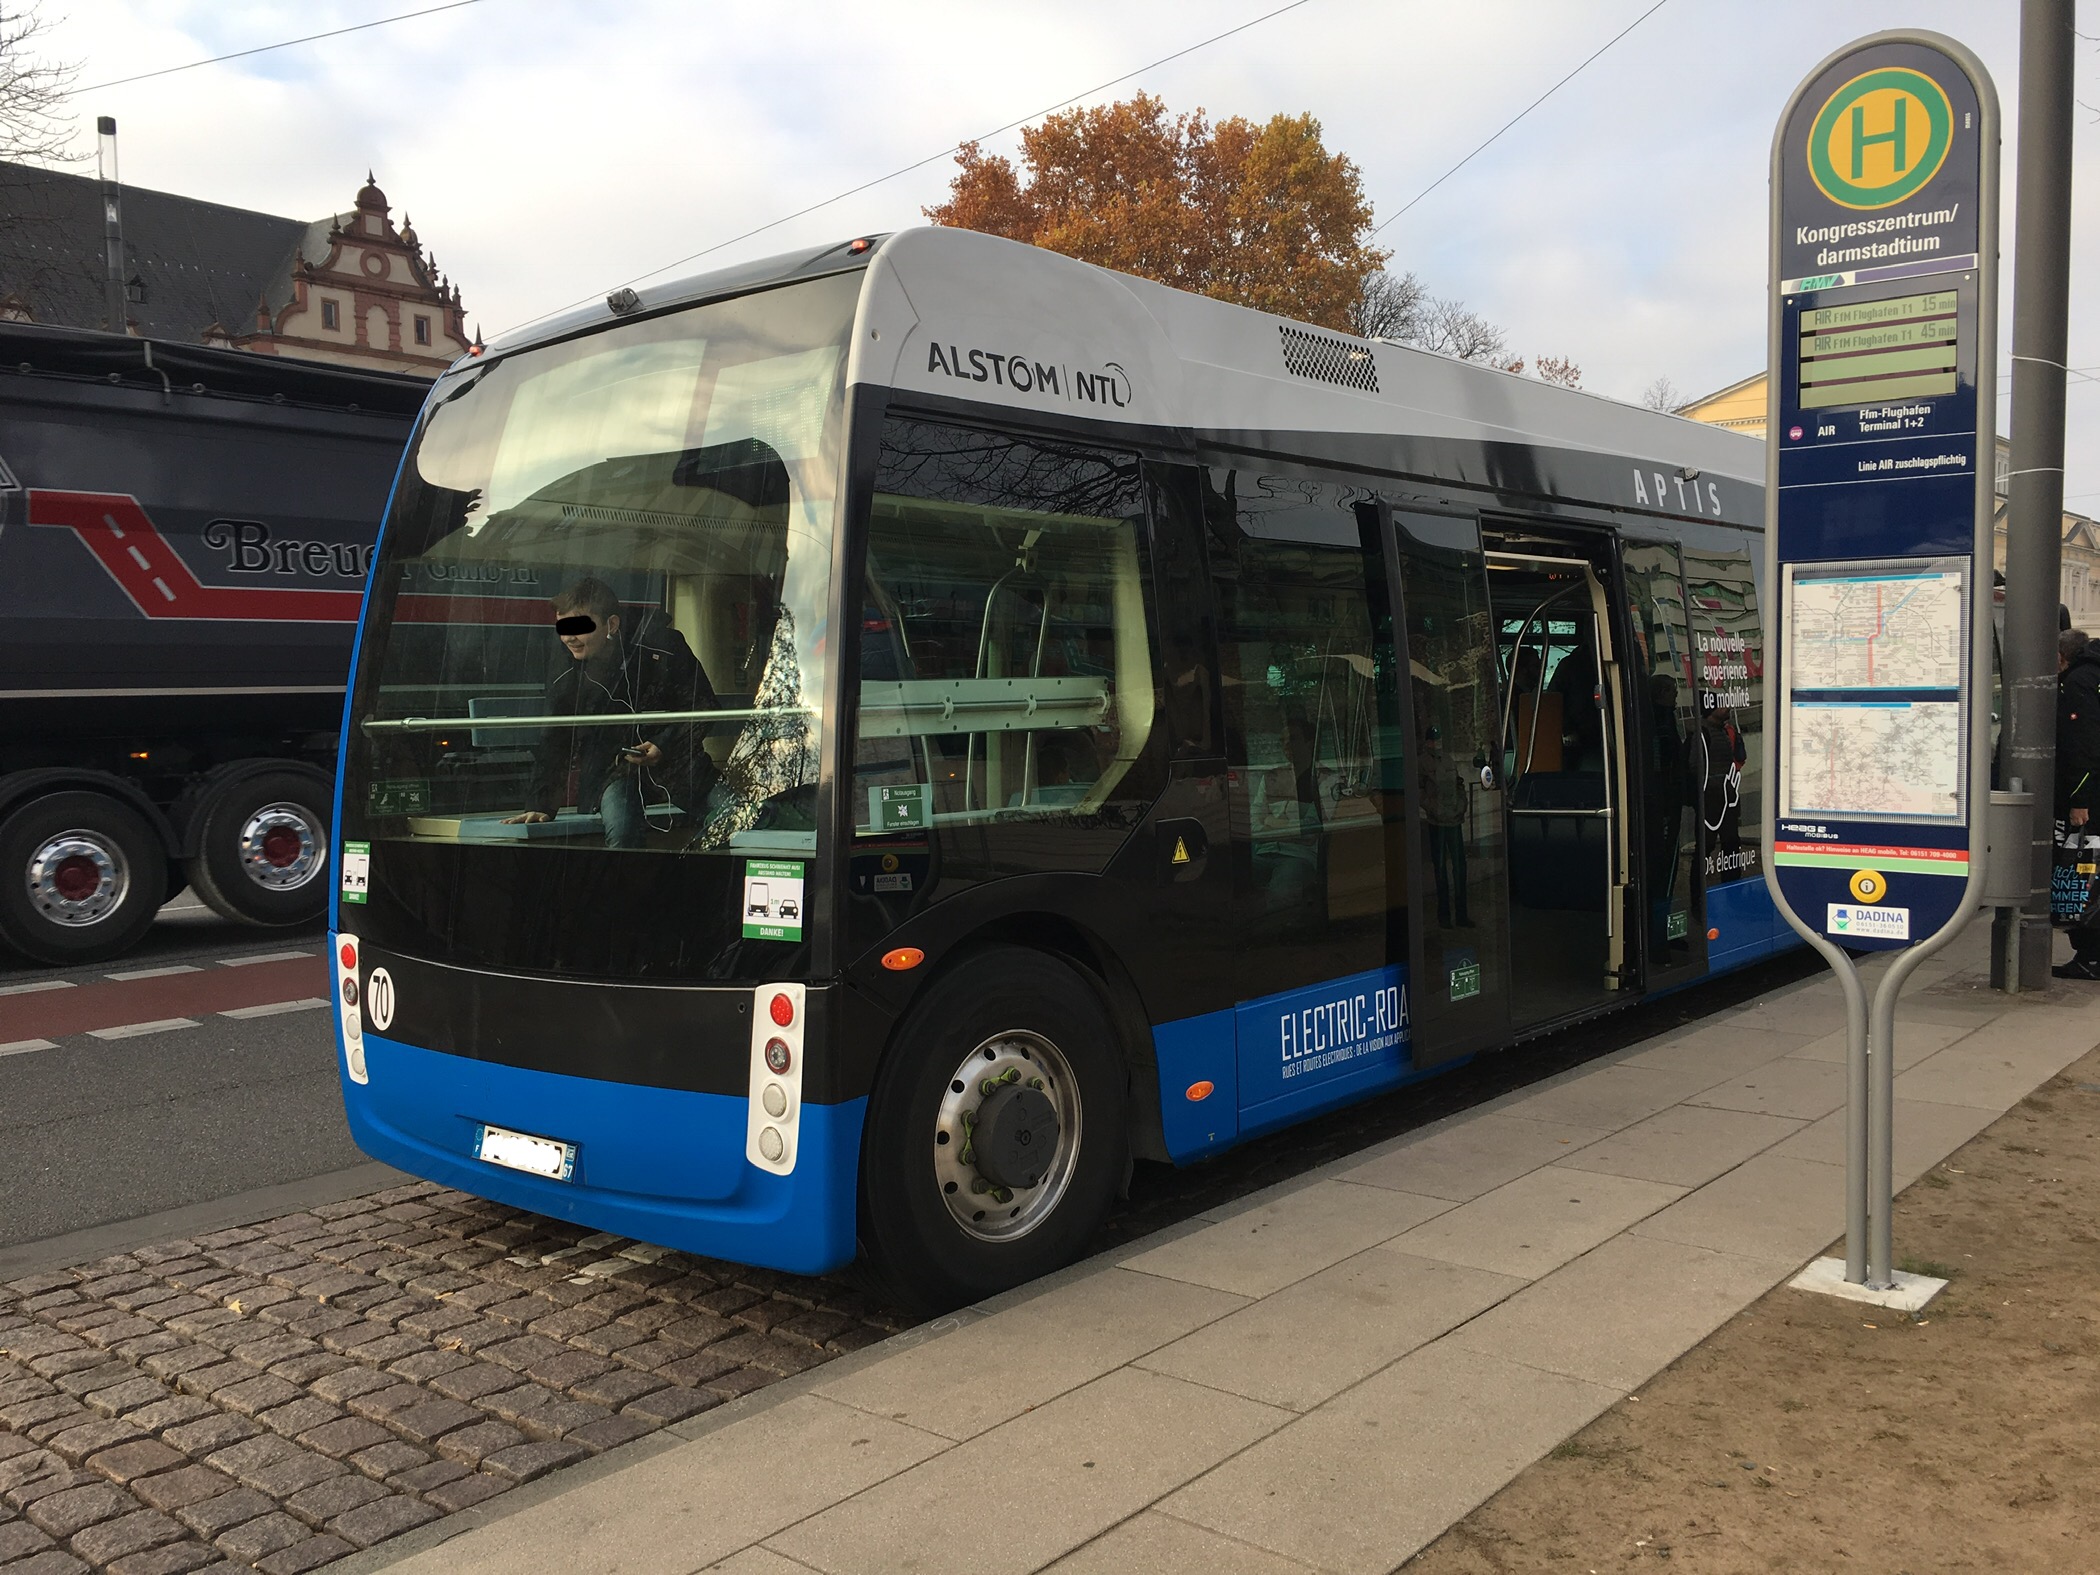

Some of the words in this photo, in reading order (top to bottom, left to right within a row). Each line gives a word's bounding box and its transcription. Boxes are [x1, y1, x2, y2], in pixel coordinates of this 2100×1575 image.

[1851, 97, 1906, 180] H
[1796, 203, 1959, 245] Kongresszentrum/
[1816, 235, 1941, 266] darmstadtium
[1814, 310, 1832, 326] AIR
[1853, 306, 1898, 322] Flughafen
[1901, 303, 1913, 315] T1
[1921, 296, 1937, 312] 15
[1938, 299, 1956, 310] min
[1814, 337, 1832, 352] AIR
[1852, 333, 1898, 348] Flughafen
[1901, 329, 1912, 341] T1
[1921, 323, 1936, 339] 45
[1938, 326, 1956, 337] min
[927, 341, 1060, 395] ALSTOM
[1076, 370, 1126, 408] NTL
[1859, 405, 1931, 420] Ffm-Flughafen
[1859, 419, 1901, 432] Terminal
[1904, 417, 1924, 428] 1+2
[1817, 425, 1836, 437] AIR
[1858, 460, 1877, 472] Linie
[1878, 459, 1894, 470] AIR
[1895, 454, 1967, 469] zuschlagspflichtig
[1633, 468, 1721, 516] APTIS
[1697, 632, 1709, 652] La
[1710, 632, 1746, 653] nouvelle
[1703, 658, 1748, 685] expérience
[1703, 687, 1715, 709] de
[1716, 686, 1750, 708] mobilité
[1716, 846, 1756, 872] électrique
[1856, 909, 1904, 923] DADINA
[759, 927, 784, 937] DANKE!
[374, 975, 389, 1022] 70
[1281, 984, 1410, 1061] ELECTRIC-ROA
[1282, 1063, 1296, 1079] RUES
[1296, 1060, 1303, 1075] ET
[1303, 1054, 1322, 1073] ROUTES
[1322, 1047, 1353, 1067] ELECTRIQUES
[1356, 1044, 1362, 1056] DE
[1363, 1042, 1369, 1054] LA
[1369, 1037, 1385, 1053] VISION
[1384, 1034, 1394, 1048] AUX
